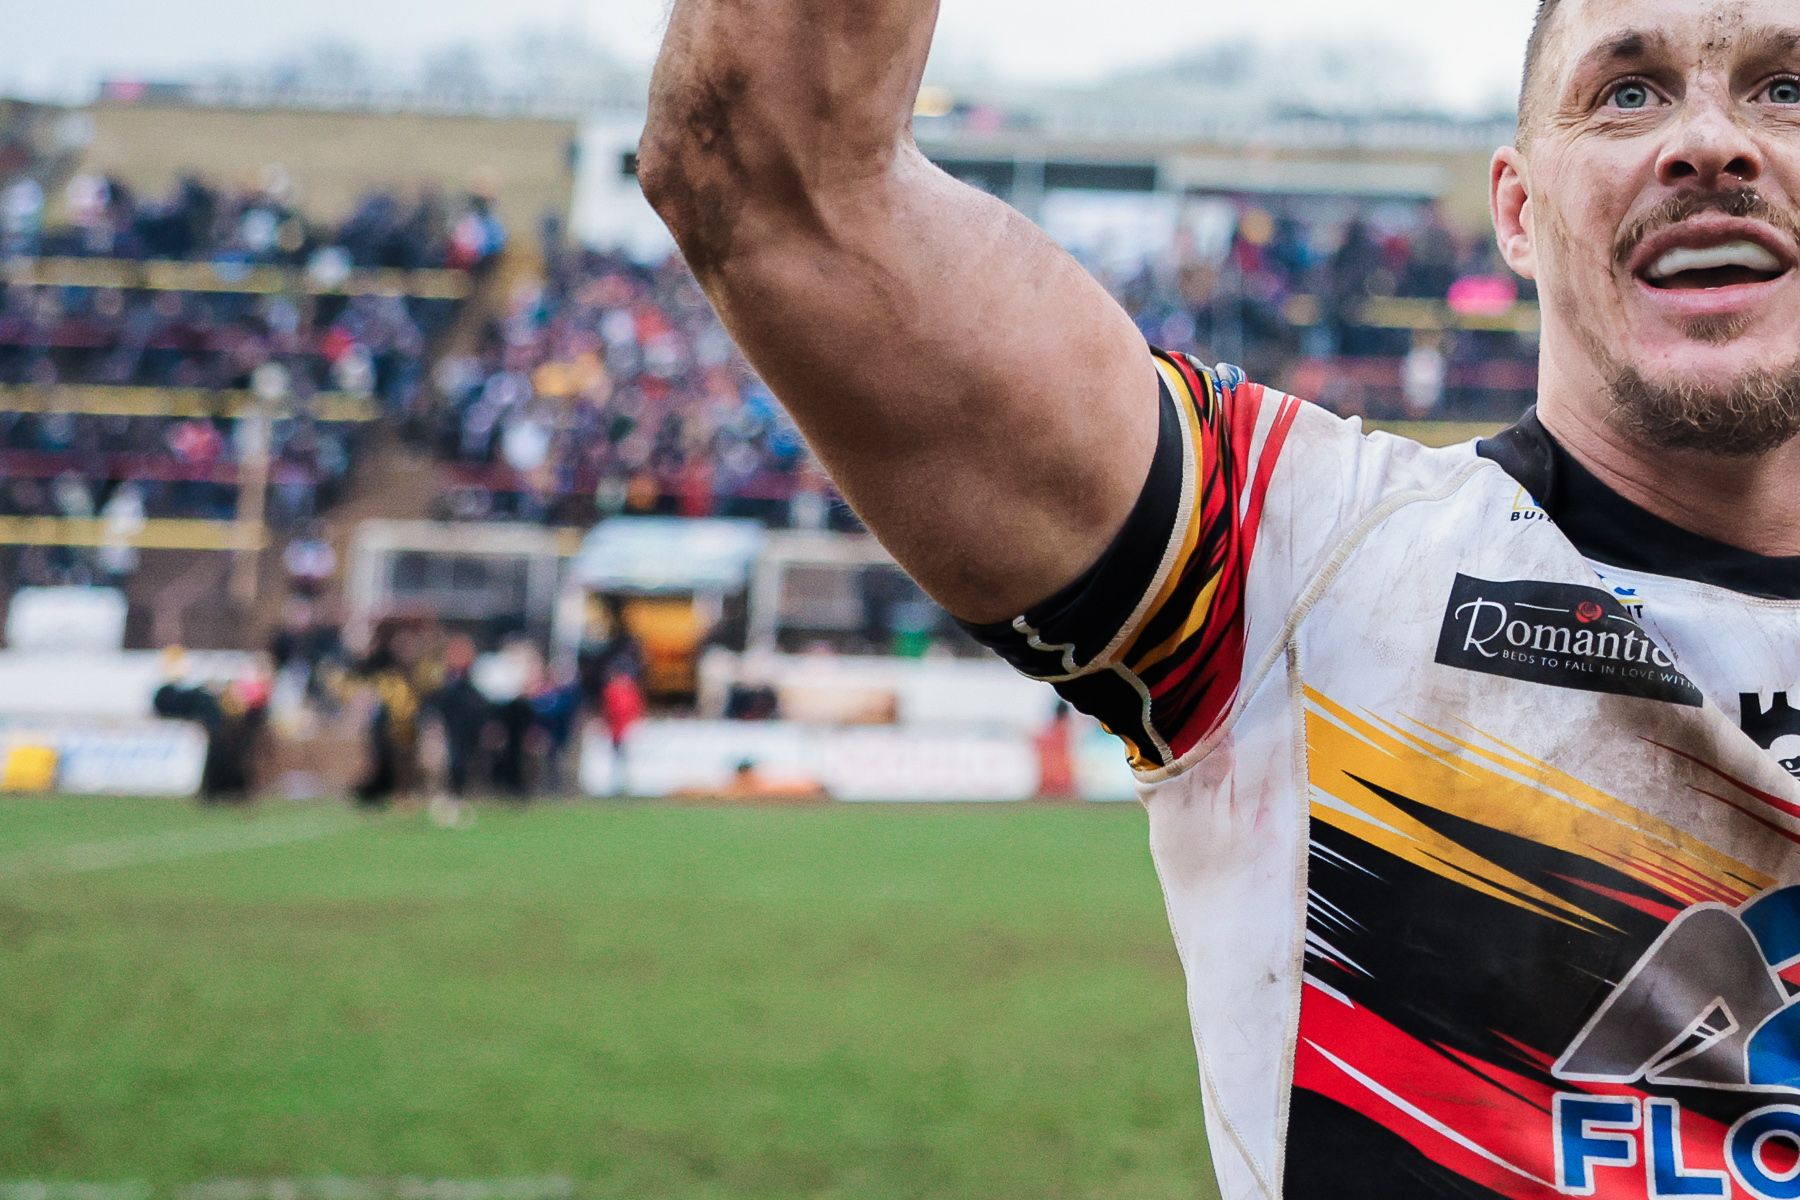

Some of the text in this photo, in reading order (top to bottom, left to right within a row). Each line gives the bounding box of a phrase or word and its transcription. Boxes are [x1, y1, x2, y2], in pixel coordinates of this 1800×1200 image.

[1502, 649, 1535, 664] BEDS
[1541, 656, 1559, 668] TO
[1565, 660, 1594, 673] FALL
[1601, 664, 1615, 675] IN
[1621, 667, 1655, 680] LOVE
